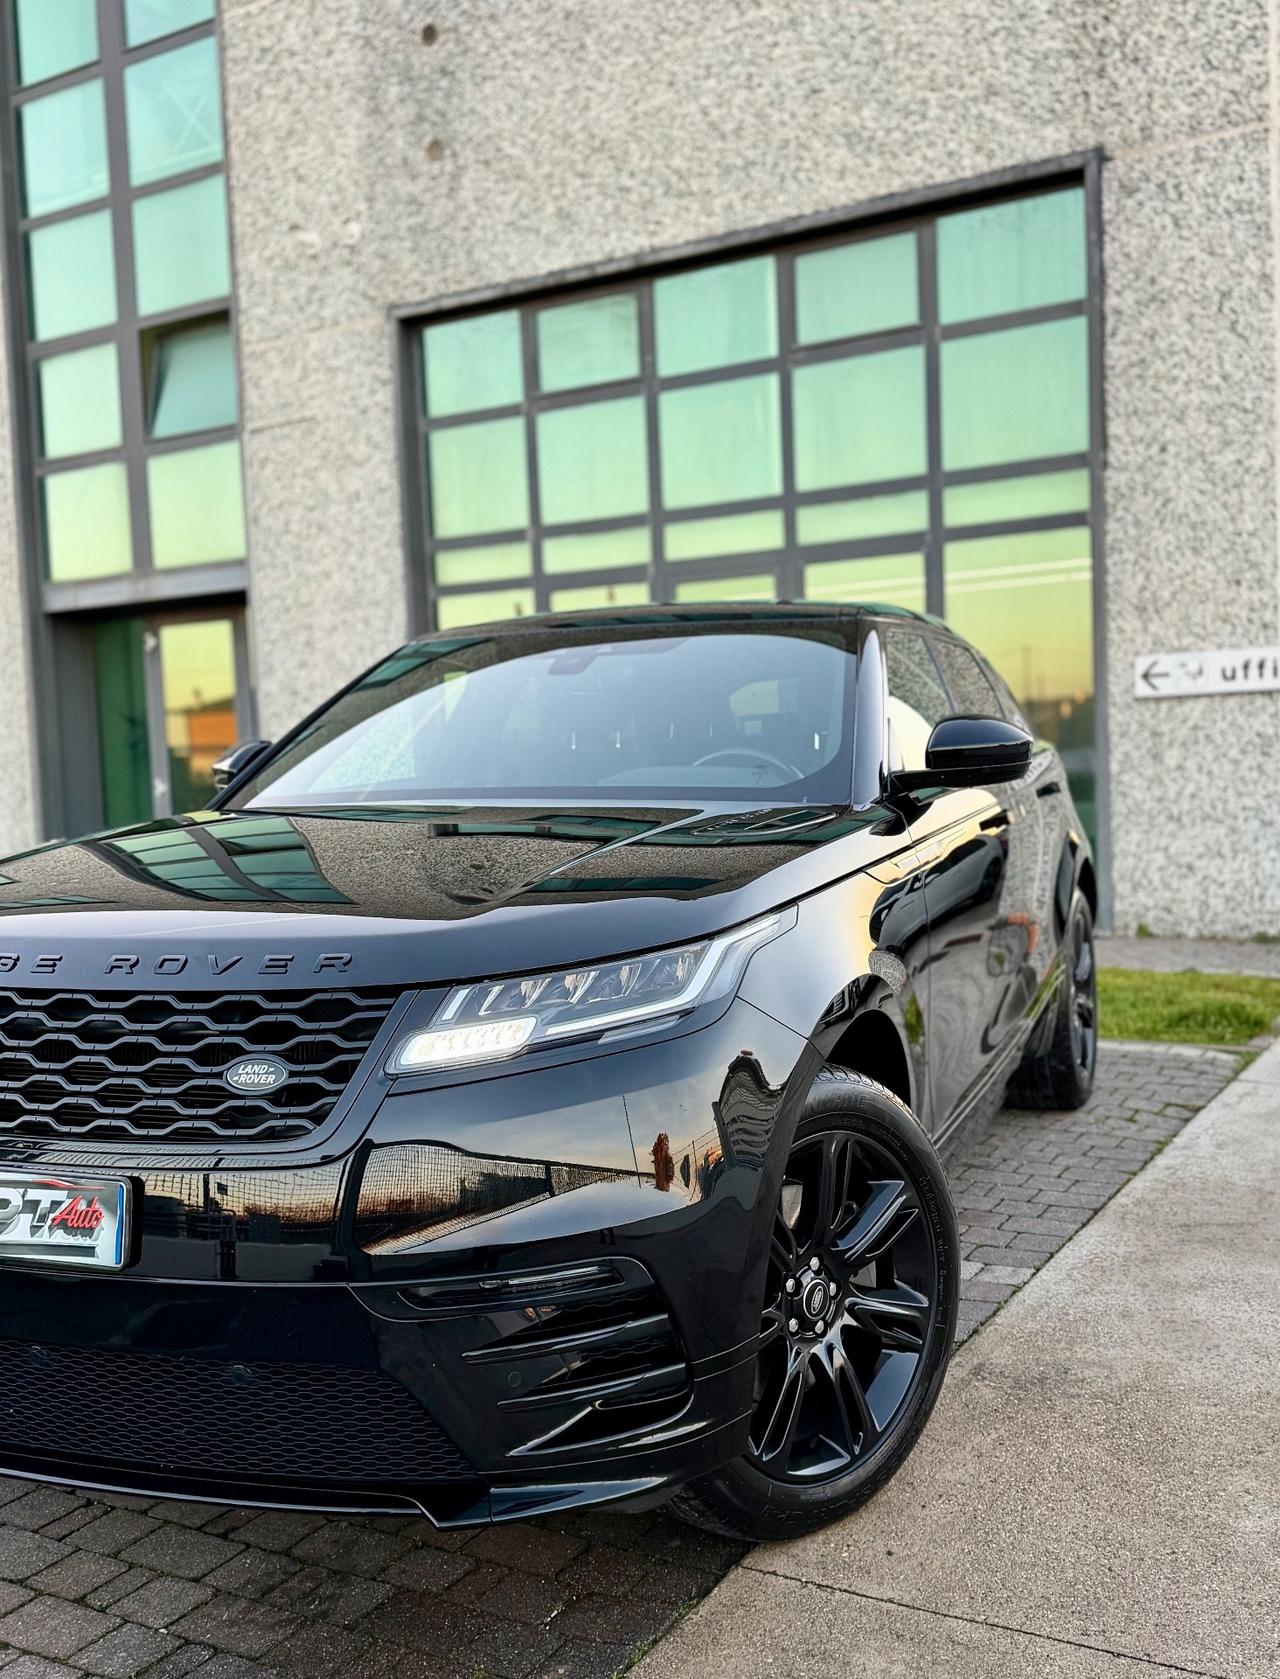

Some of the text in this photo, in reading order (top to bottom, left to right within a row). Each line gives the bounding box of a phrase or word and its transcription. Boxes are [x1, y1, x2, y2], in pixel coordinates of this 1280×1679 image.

[1221, 656, 1279, 681] uffi
[104, 952, 353, 975] ROVER
[238, 1065, 269, 1073] LAND
[238, 1074, 276, 1083] ROVER
[51, 1195, 104, 1228] Auto
